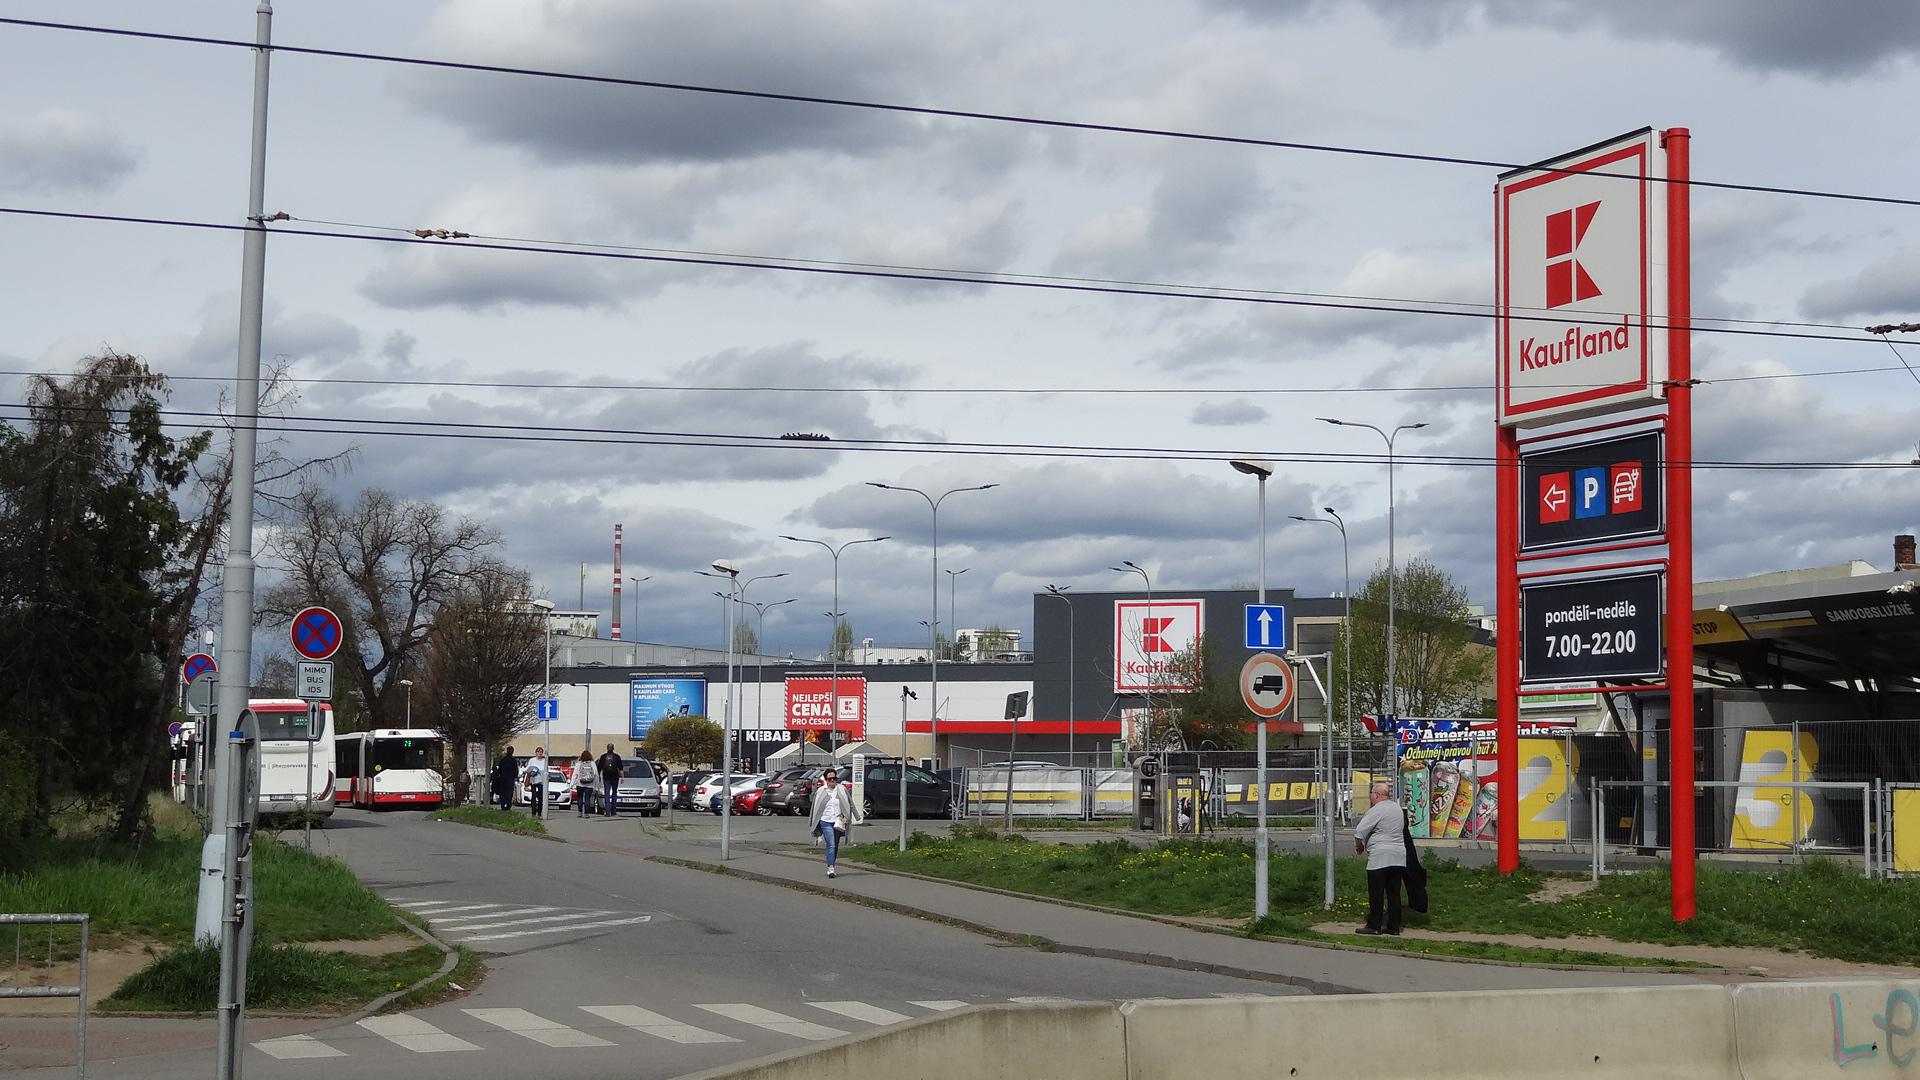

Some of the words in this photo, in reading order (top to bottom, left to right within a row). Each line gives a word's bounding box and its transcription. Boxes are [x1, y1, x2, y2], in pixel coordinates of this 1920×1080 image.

[1519, 313, 1629, 372] Kaufland
[1584, 477, 1599, 509] P
[1825, 600, 1915, 623] SAMOOBSLUŽNÉ
[1545, 629, 1636, 659] 7.00-22.00
[304, 666, 326, 674] MIMO
[306, 676, 323, 684] BUS
[308, 686, 321, 694] IDS
[792, 692, 832, 702] NEJLEPŠÍ
[791, 703, 832, 717] CENA
[809, 717, 832, 725] ČESKO
[745, 730, 791, 742] KEBAB
[1828, 988, 1920, 1067] Le
